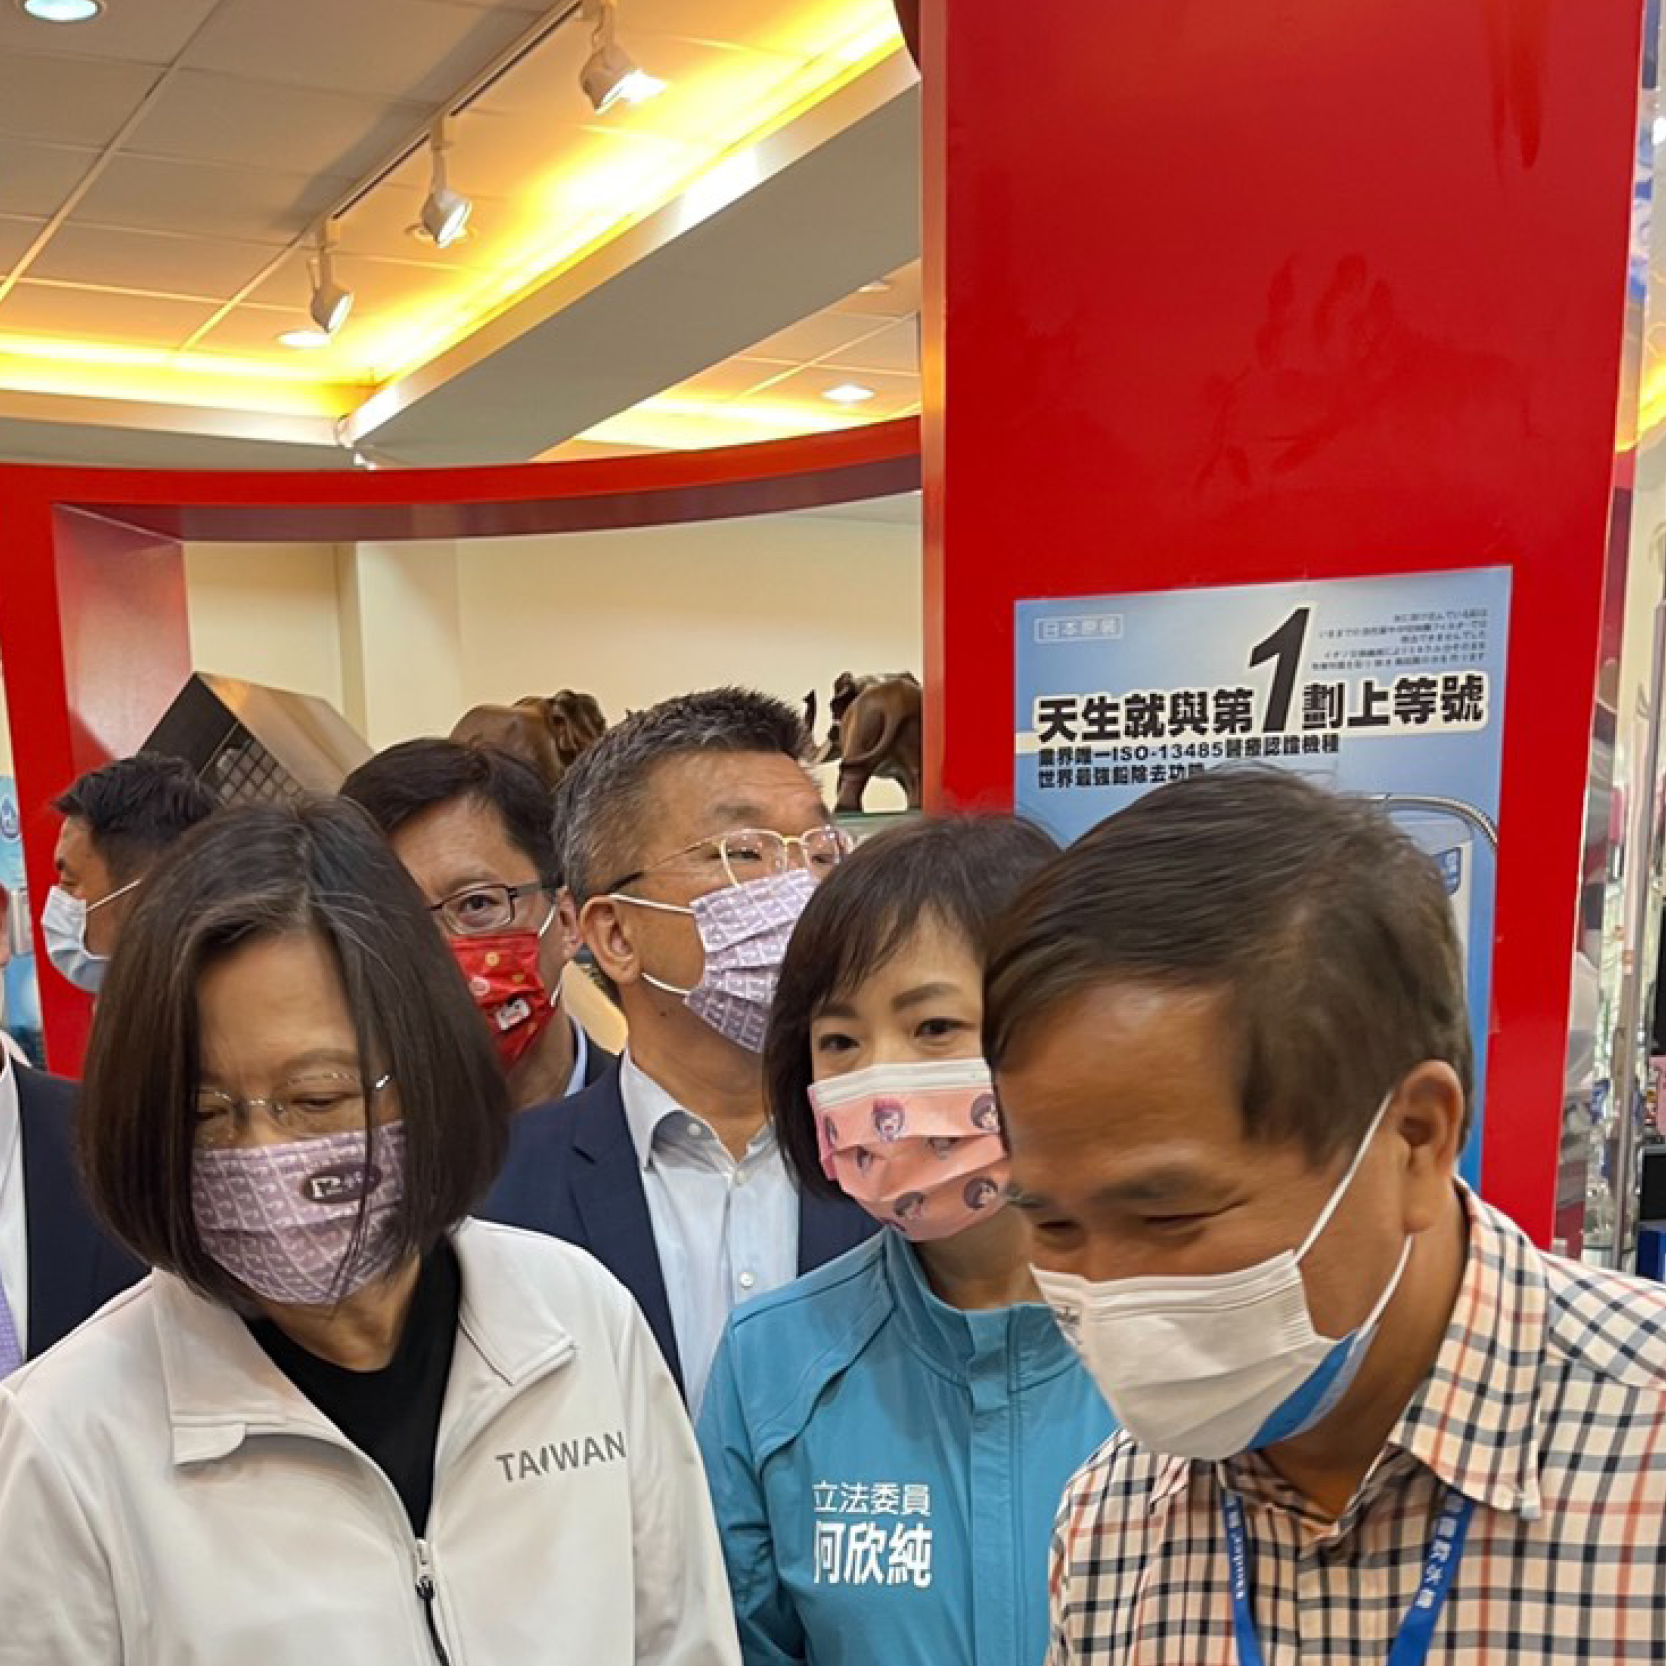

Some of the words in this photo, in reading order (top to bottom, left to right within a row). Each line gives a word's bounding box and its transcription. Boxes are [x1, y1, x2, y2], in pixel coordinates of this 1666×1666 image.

[496, 1431, 627, 1483] TAIWAN
[812, 1480, 931, 1517] 立法委員
[813, 1520, 933, 1588] 何欣純
